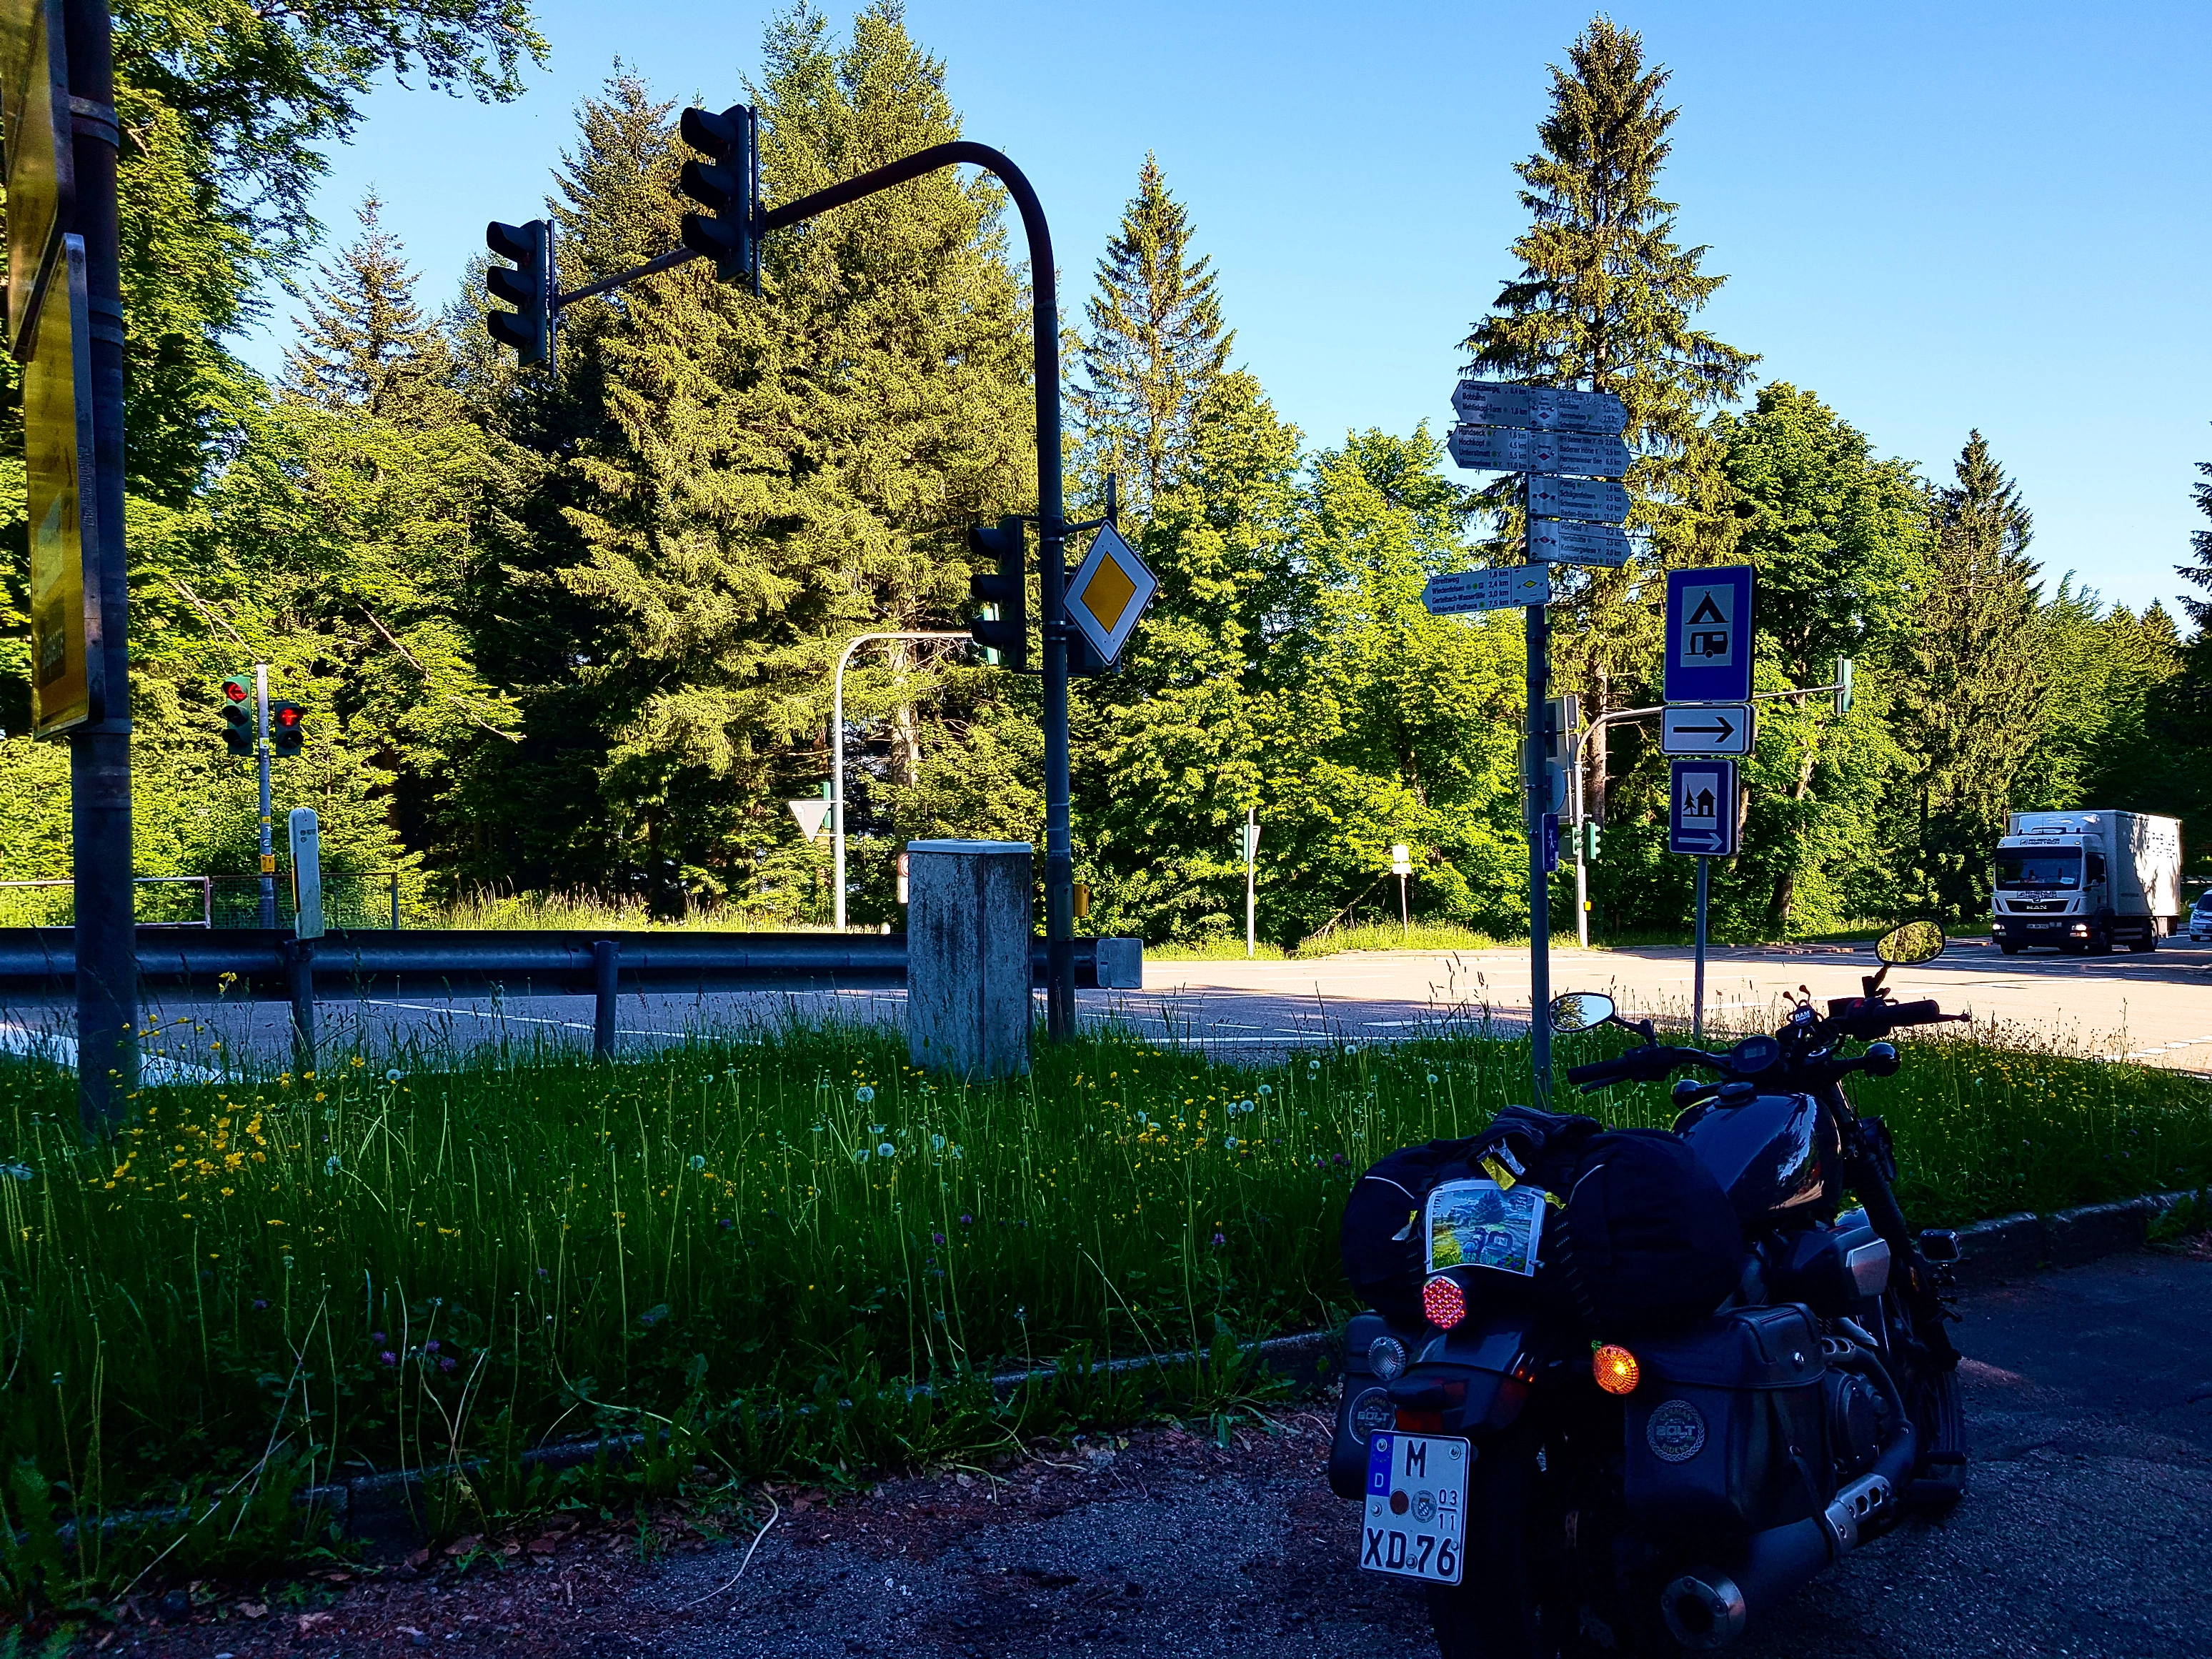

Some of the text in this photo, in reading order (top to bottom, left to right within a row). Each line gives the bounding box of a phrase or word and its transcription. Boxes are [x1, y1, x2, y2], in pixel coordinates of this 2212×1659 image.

[1458, 438, 1485, 448] Hochkopf
[1459, 449, 1490, 457] Unterstmatt
[1560, 445, 1580, 454] Badener
[1560, 509, 1593, 519] Baden-Baden
[1560, 522, 1583, 532] Vorfeld
[1432, 577, 1460, 585] Streitweg
[1432, 585, 1465, 594] Wiedenfelsen
[1432, 592, 1485, 604] Gertelbach-Wasserfälle
[1433, 604, 1455, 614] Bühlertal
[1456, 602, 1478, 612] Rathaus
[1795, 1010, 1810, 1020] RAM
[1357, 1411, 1390, 1422] BOLT
[1656, 1425, 1695, 1436] BOLT
[1662, 1443, 1690, 1453] RIDERS
[1405, 1440, 1427, 1478] M
[1375, 1473, 1384, 1488] D
[1439, 1488, 1458, 1506] 03
[1439, 1513, 1455, 1530] 11
[1364, 1527, 1456, 1576] XD 76
